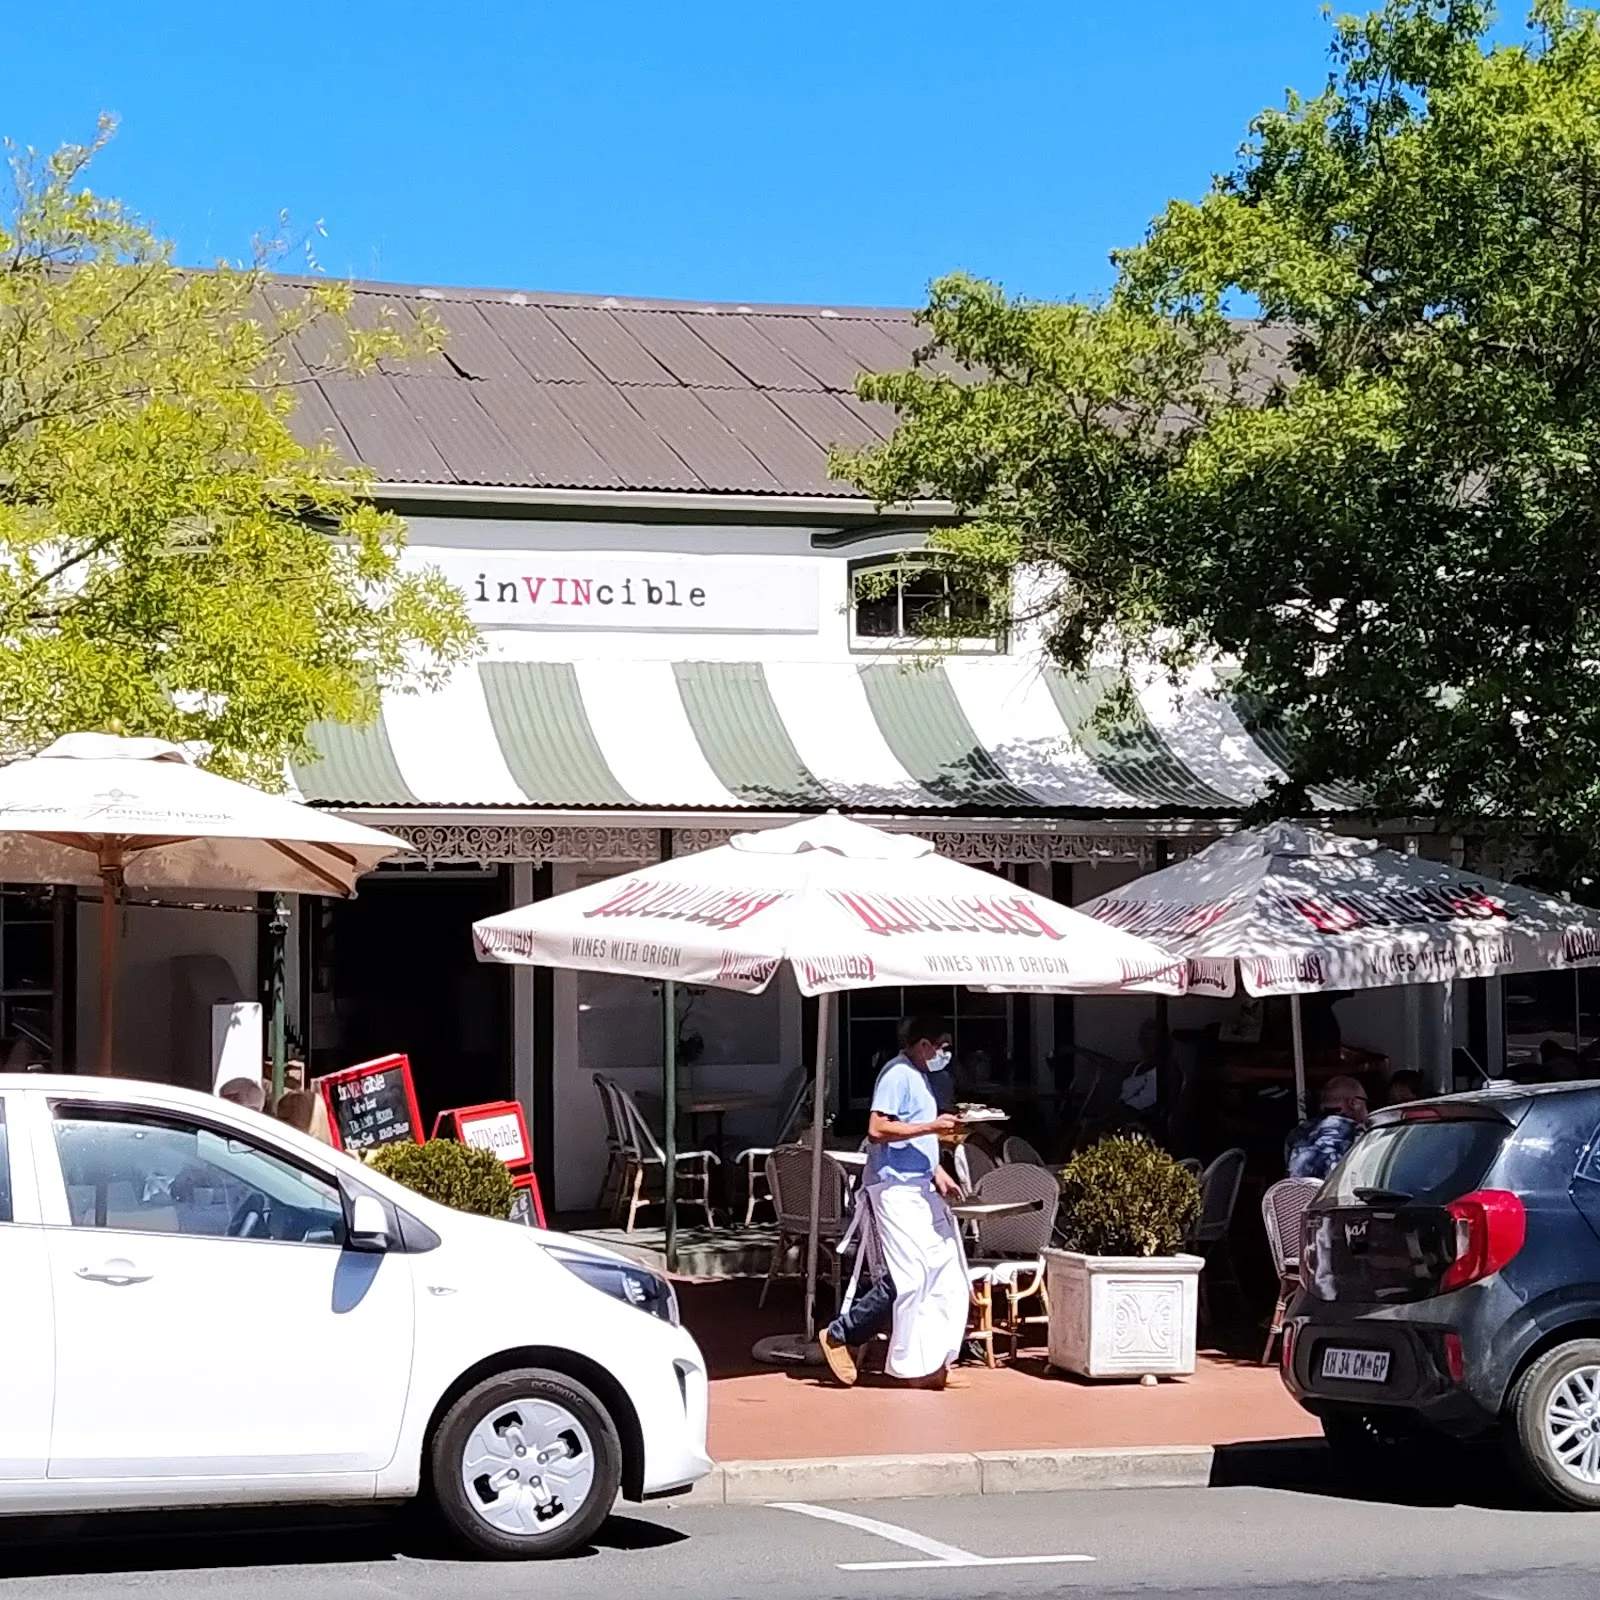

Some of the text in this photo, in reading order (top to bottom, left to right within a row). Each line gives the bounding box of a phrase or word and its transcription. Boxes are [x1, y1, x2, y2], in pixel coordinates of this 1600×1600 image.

[474, 573, 707, 608] inVINcible
[572, 937, 682, 967] WINES WITH ORIGIN
[924, 955, 1070, 975] WINES WITH ORIGIN
[1370, 937, 1513, 975] WINES WITH ORIGIN
[1373, 1354, 1387, 1378] GP
